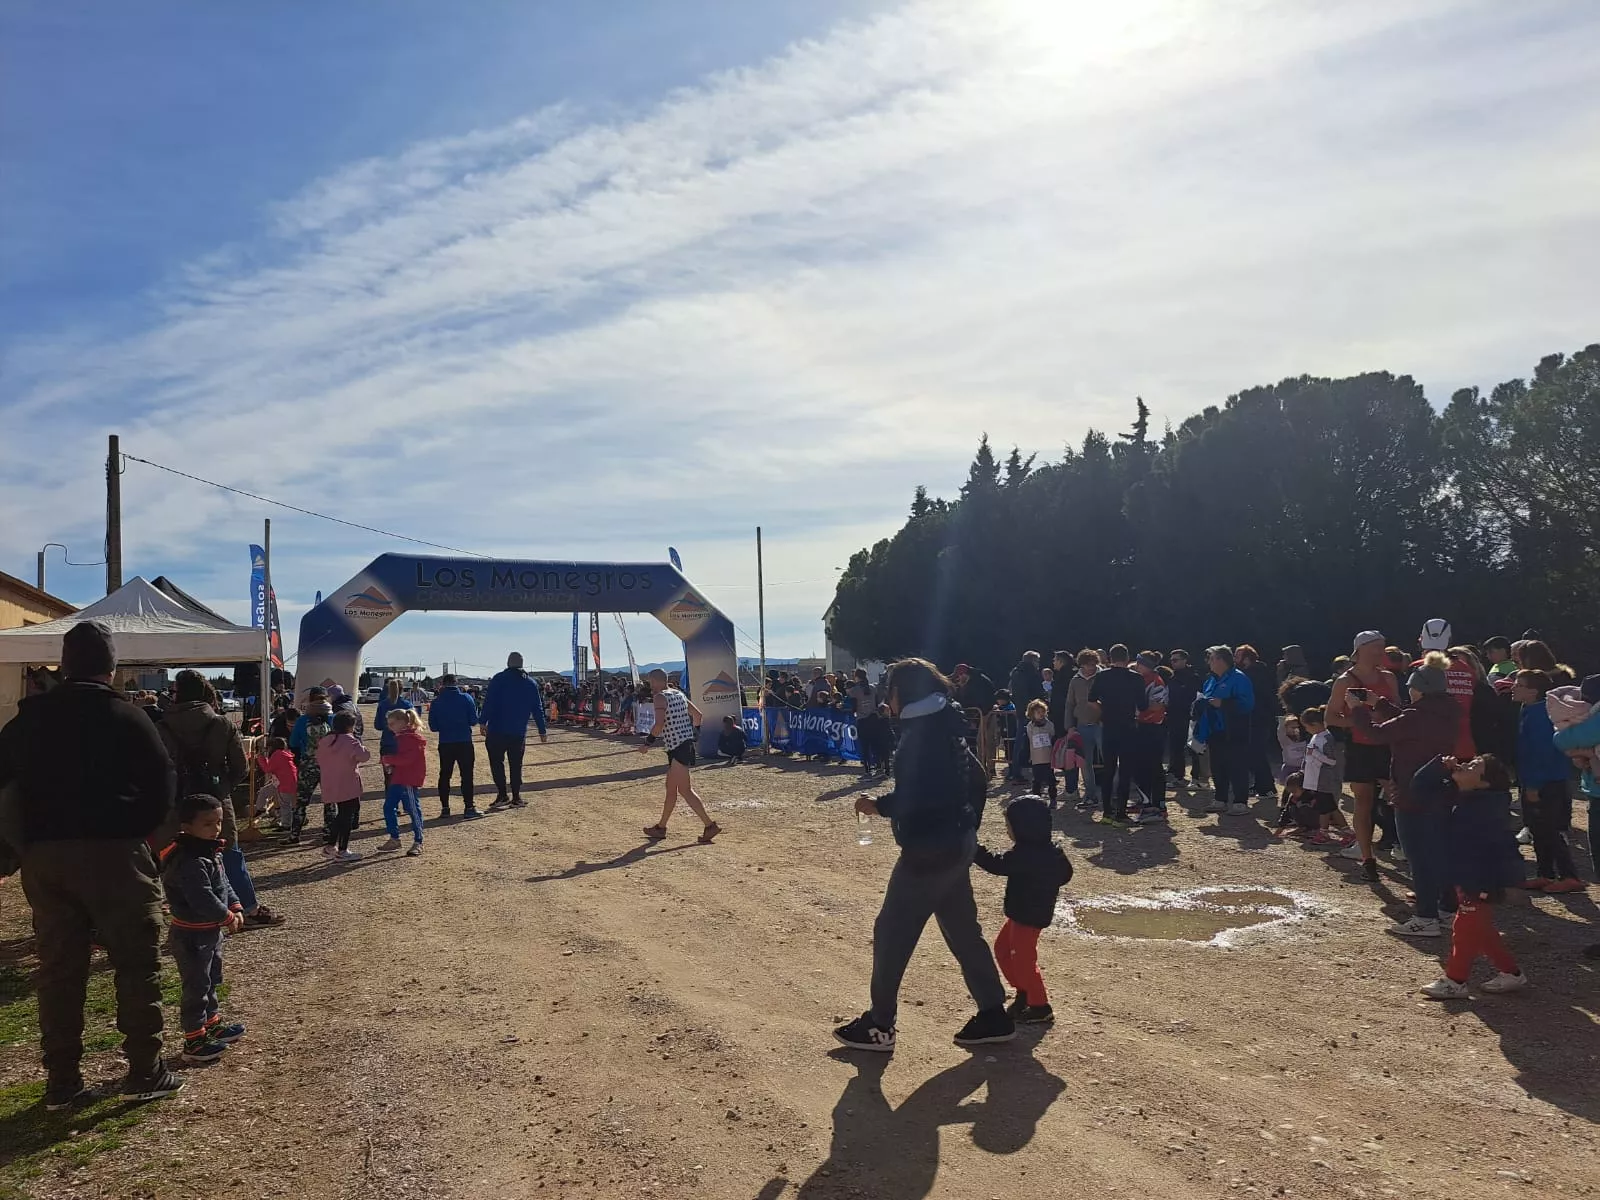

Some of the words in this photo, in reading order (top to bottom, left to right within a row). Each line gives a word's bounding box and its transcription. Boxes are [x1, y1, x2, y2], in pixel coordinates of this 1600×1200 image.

[416, 562, 476, 589] Los
[490, 566, 653, 596] Monegros
[360, 610, 393, 618] Monegros
[803, 712, 859, 741] Monegro
